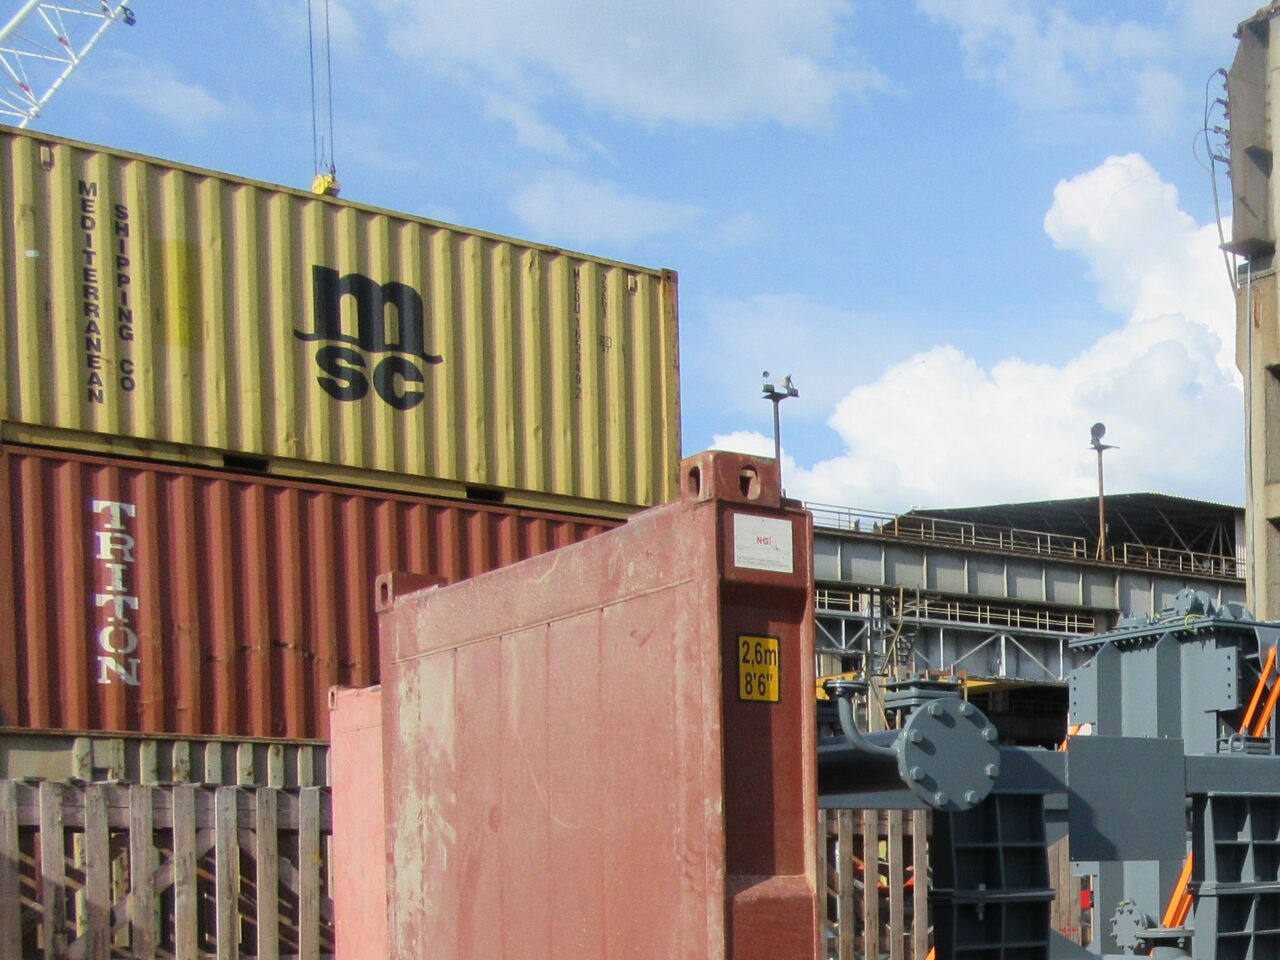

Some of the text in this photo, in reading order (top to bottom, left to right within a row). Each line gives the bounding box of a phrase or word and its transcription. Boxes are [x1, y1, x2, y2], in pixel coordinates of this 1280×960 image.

[78, 179, 104, 404] MEDITERRANEAN
[115, 204, 136, 392] SHIPPING CO
[92, 500, 141, 686] TRITON
[742, 640, 777, 668] 2,6m
[744, 672, 773, 696] 8'6"
